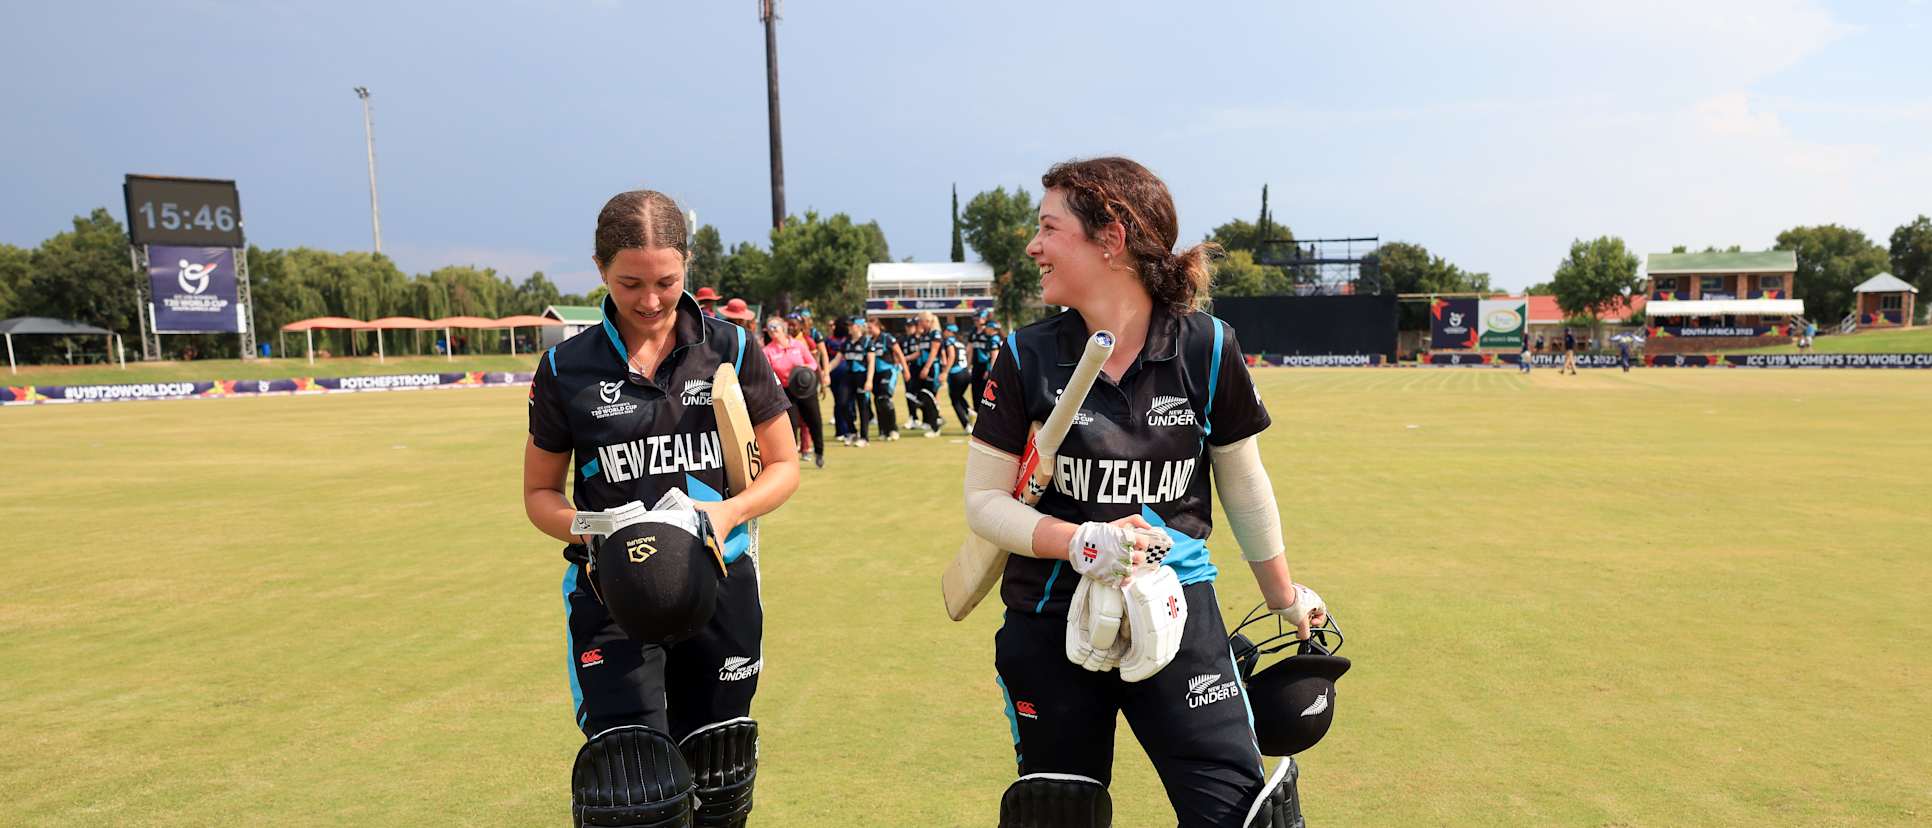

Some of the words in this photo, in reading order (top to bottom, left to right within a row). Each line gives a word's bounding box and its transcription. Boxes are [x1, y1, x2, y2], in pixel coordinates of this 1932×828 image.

[139, 202, 235, 232] 15:46
[1681, 328, 1706, 336] SOUTH
[1708, 328, 1734, 336] AFRICA
[1283, 355, 1370, 365] POTCHEFSTROOM
[1531, 355, 1553, 365] UTH
[1746, 355, 1765, 365] ICC
[1789, 355, 1844, 365] WOMEN'S
[1845, 355, 1867, 365] T20
[1868, 355, 1913, 365] WORLD
[1914, 355, 1932, 365] CU
[340, 374, 440, 389] POTCHEFSTROOM
[64, 383, 195, 400] #U19T20WORLDCUP
[682, 396, 712, 405] UNDE
[603, 406, 625, 414] WORLD
[1148, 415, 1194, 427] UNDER
[598, 439, 645, 484] NEW
[648, 431, 723, 475] ZEALAN
[1097, 458, 1196, 504] ZEALAND
[626, 535, 656, 547] MASURI
[719, 671, 752, 681] UNDER
[1207, 684, 1221, 693] NEW
[1189, 688, 1230, 708] UNDER
[1230, 685, 1239, 697] 19
